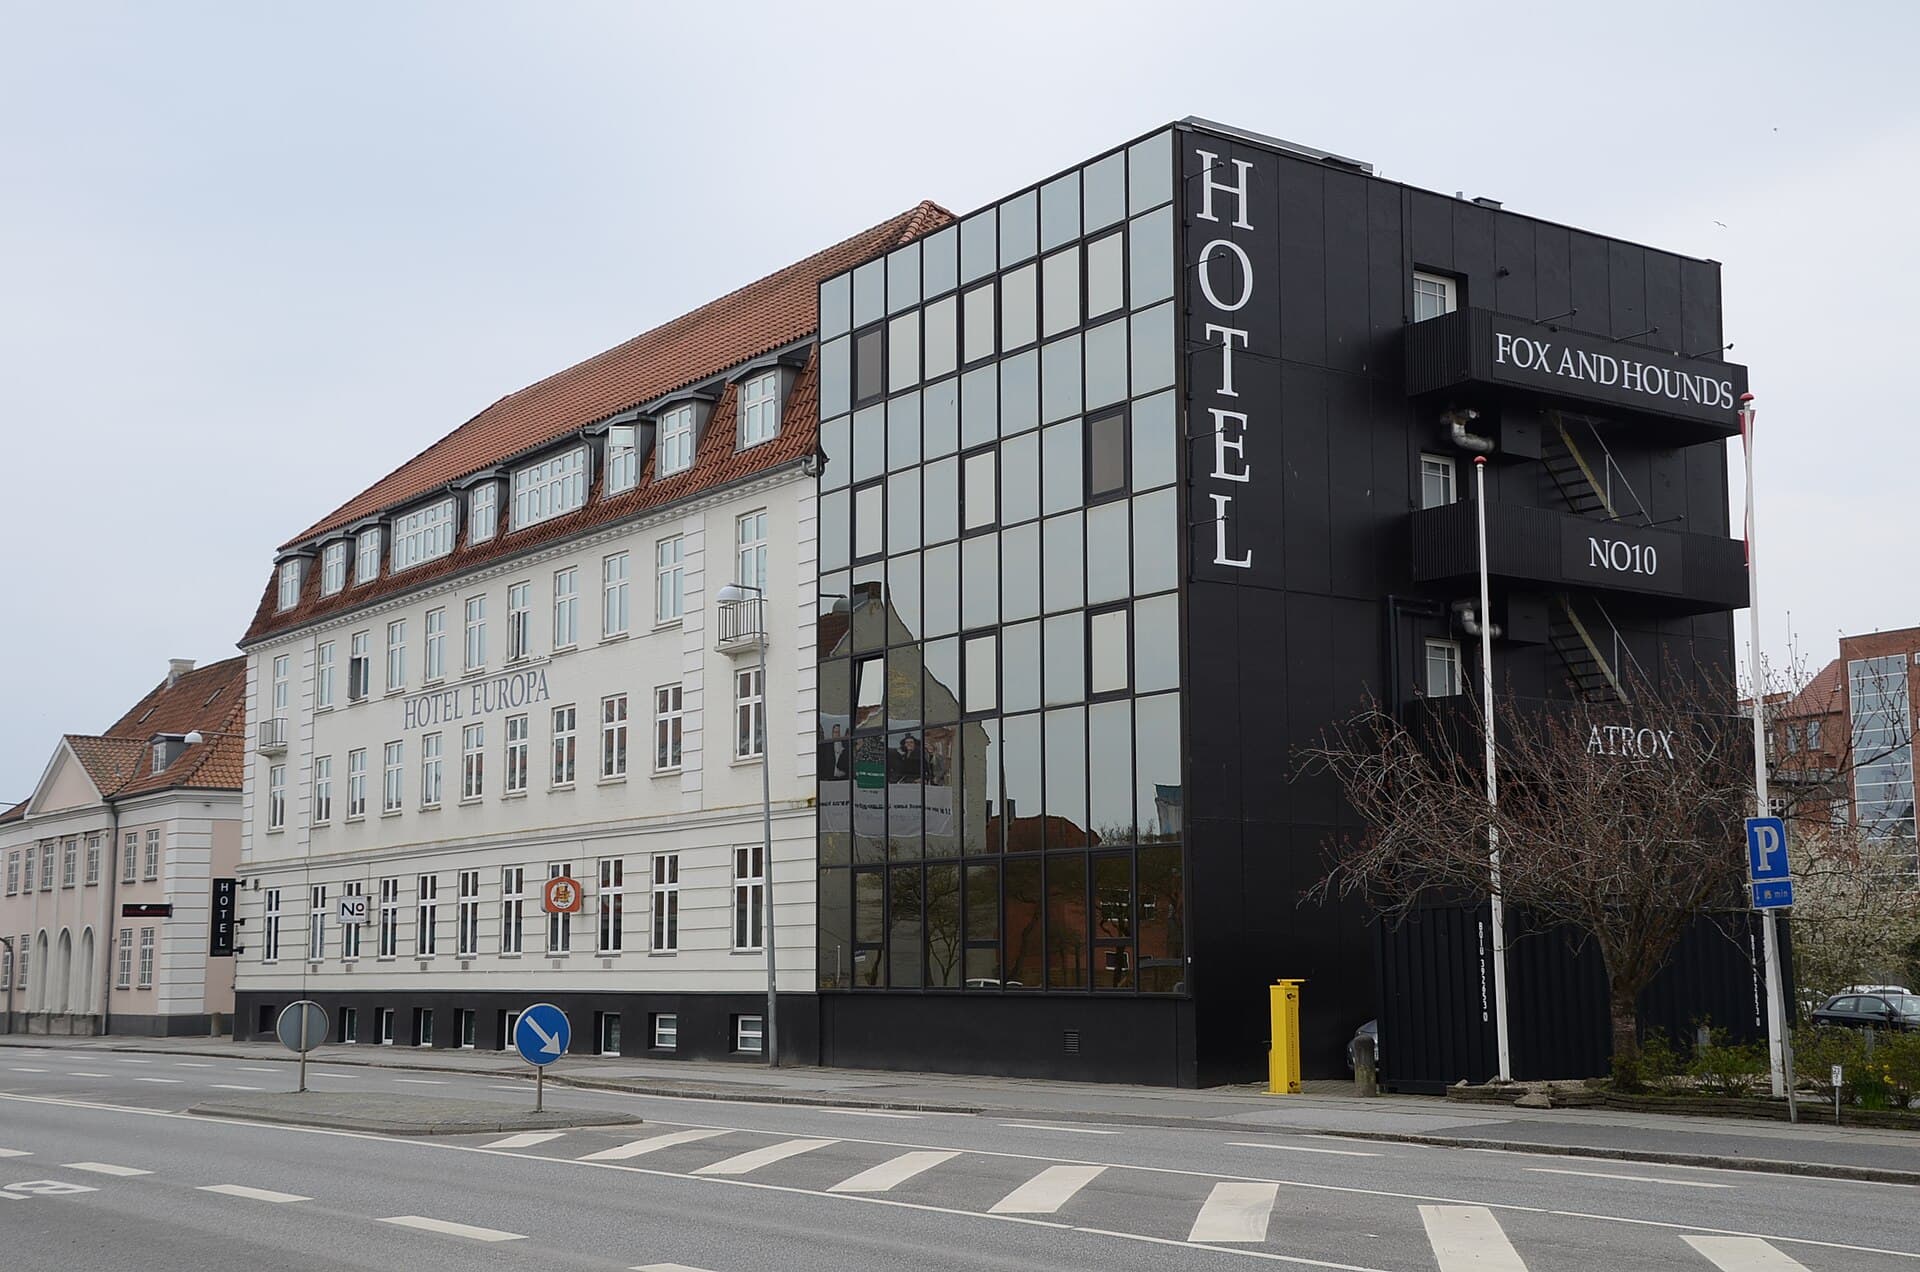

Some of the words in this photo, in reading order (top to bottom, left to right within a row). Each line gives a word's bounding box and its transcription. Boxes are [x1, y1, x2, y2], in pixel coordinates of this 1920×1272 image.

[1195, 149, 1255, 569] HOTEL
[1496, 333, 1551, 373] FOX
[1556, 347, 1618, 385] AND
[1621, 359, 1733, 409] HOUNDS
[1589, 537, 1657, 576] NO10
[404, 689, 463, 730] HOTEL
[471, 668, 550, 716] EUROPA
[1587, 725, 1674, 760] ATROX
[1754, 826, 1779, 871] P
[219, 882, 229, 947] HOTEL
